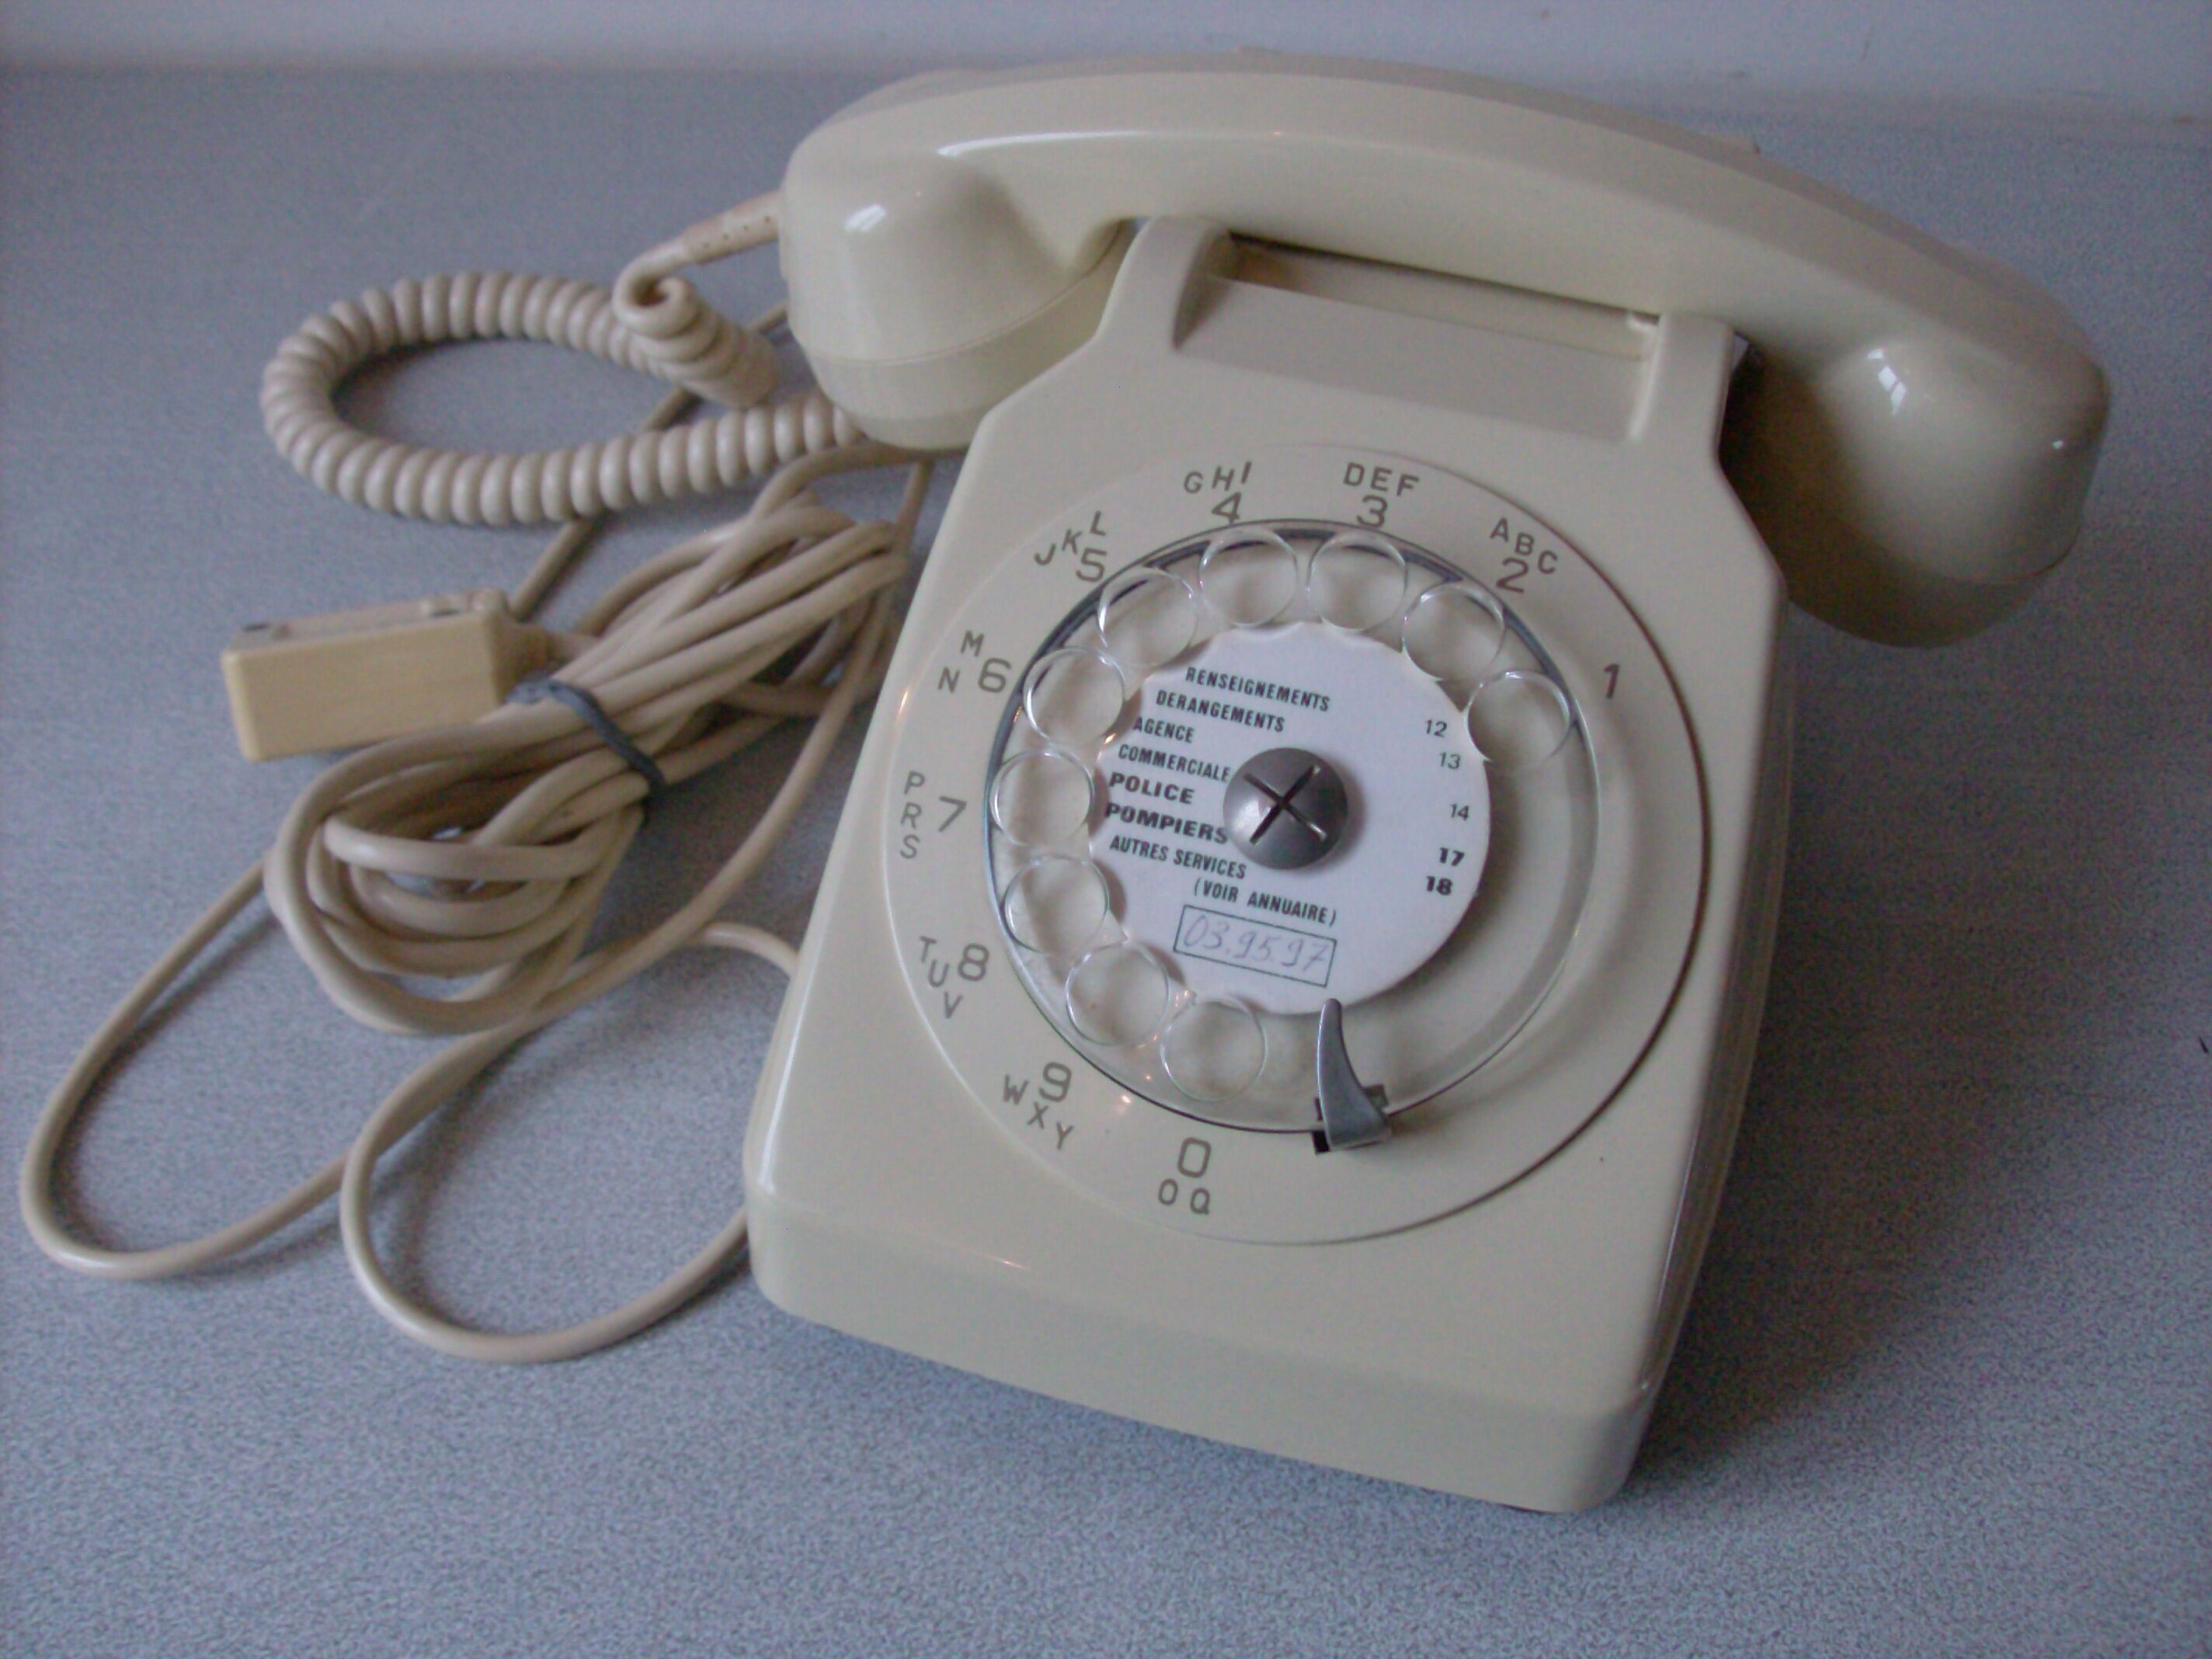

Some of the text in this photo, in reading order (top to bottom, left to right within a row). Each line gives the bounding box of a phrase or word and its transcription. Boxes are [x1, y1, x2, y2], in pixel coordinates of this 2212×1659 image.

[1212, 494, 1240, 522] 4
[1356, 495, 1387, 527] 3
[1076, 548, 1106, 583] 5
[1497, 559, 1529, 593] 2
[979, 657, 1010, 694] 6
[1186, 667, 1330, 711] RENSEIGNEMENTS
[1602, 662, 1621, 700] 1
[1156, 690, 1285, 732] DERANGEMENTS
[1133, 717, 1195, 743] AGENCE
[1425, 720, 1447, 738] 12
[1118, 744, 1231, 782] COMMERCIALE
[1439, 753, 1462, 769] 13
[1110, 773, 1195, 804] POLICE
[937, 797, 966, 833] 7
[1105, 803, 1228, 845] POMPIERS
[1450, 804, 1469, 820] 14
[1110, 836, 1247, 879] AUTRES SERVICES
[1439, 848, 1464, 868] 17
[1195, 878, 1336, 927] (VOIR ANNUAIRE)
[1427, 876, 1452, 896] 18
[958, 943, 989, 981] 8
[1040, 1062, 1072, 1101] 9
